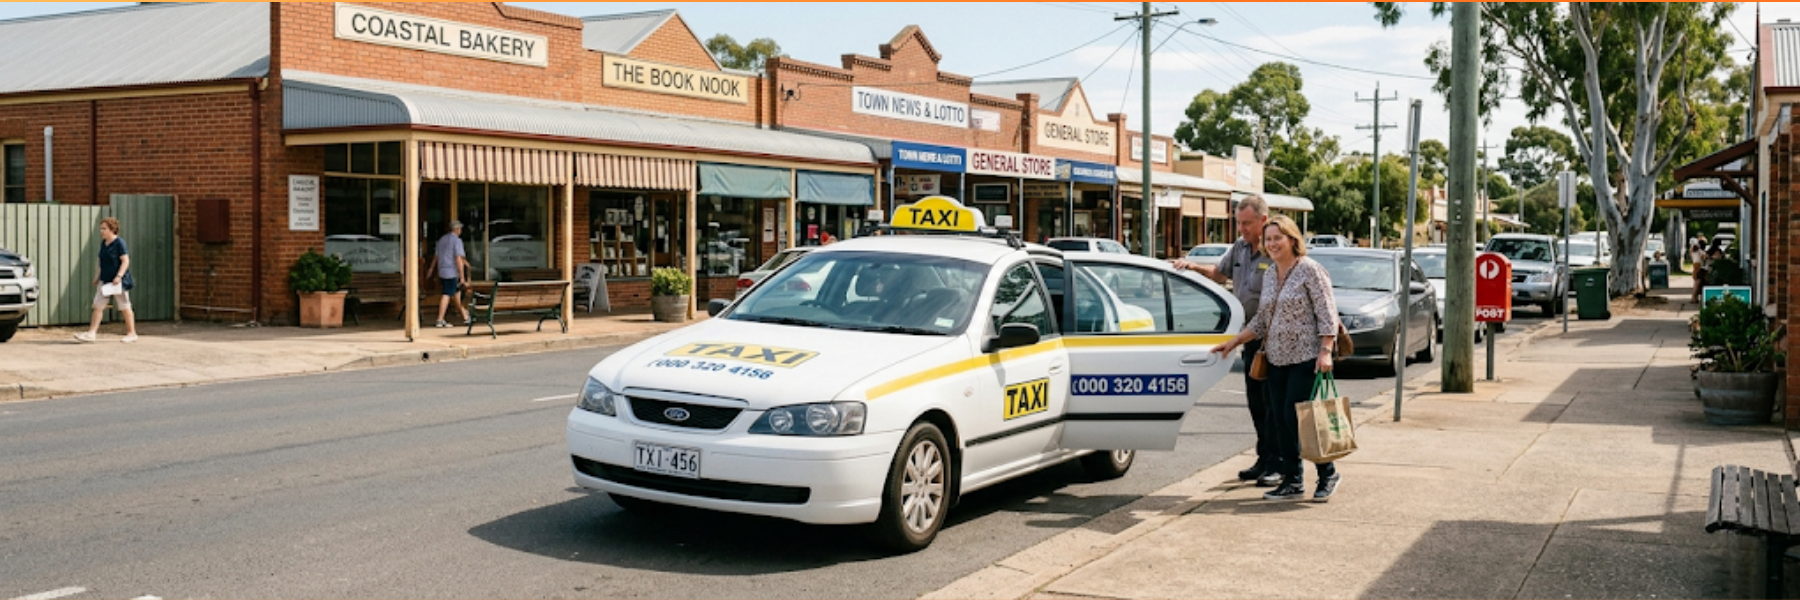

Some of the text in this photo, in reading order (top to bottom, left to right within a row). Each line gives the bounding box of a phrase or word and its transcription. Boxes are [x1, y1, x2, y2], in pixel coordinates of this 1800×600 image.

[352, 13, 535, 58] COASTAL BAKERY
[612, 62, 740, 97] THE BOOK NOOK
[857, 91, 889, 112] TOWN
[892, 97, 921, 117] NEWS
[924, 102, 931, 118] &
[934, 104, 965, 123] LOTTO
[1044, 121, 1109, 146] GENERAL STORE
[972, 151, 1019, 172] GENERAL
[1022, 156, 1051, 176] STORE
[908, 207, 959, 227] TAXI
[1475, 308, 1505, 319] POST
[688, 343, 809, 365] TAXI
[691, 361, 727, 371] 320
[728, 366, 774, 379] 4156
[1113, 377, 1143, 393] 320
[1147, 377, 1186, 393] 4156
[1007, 381, 1048, 416] TAXI
